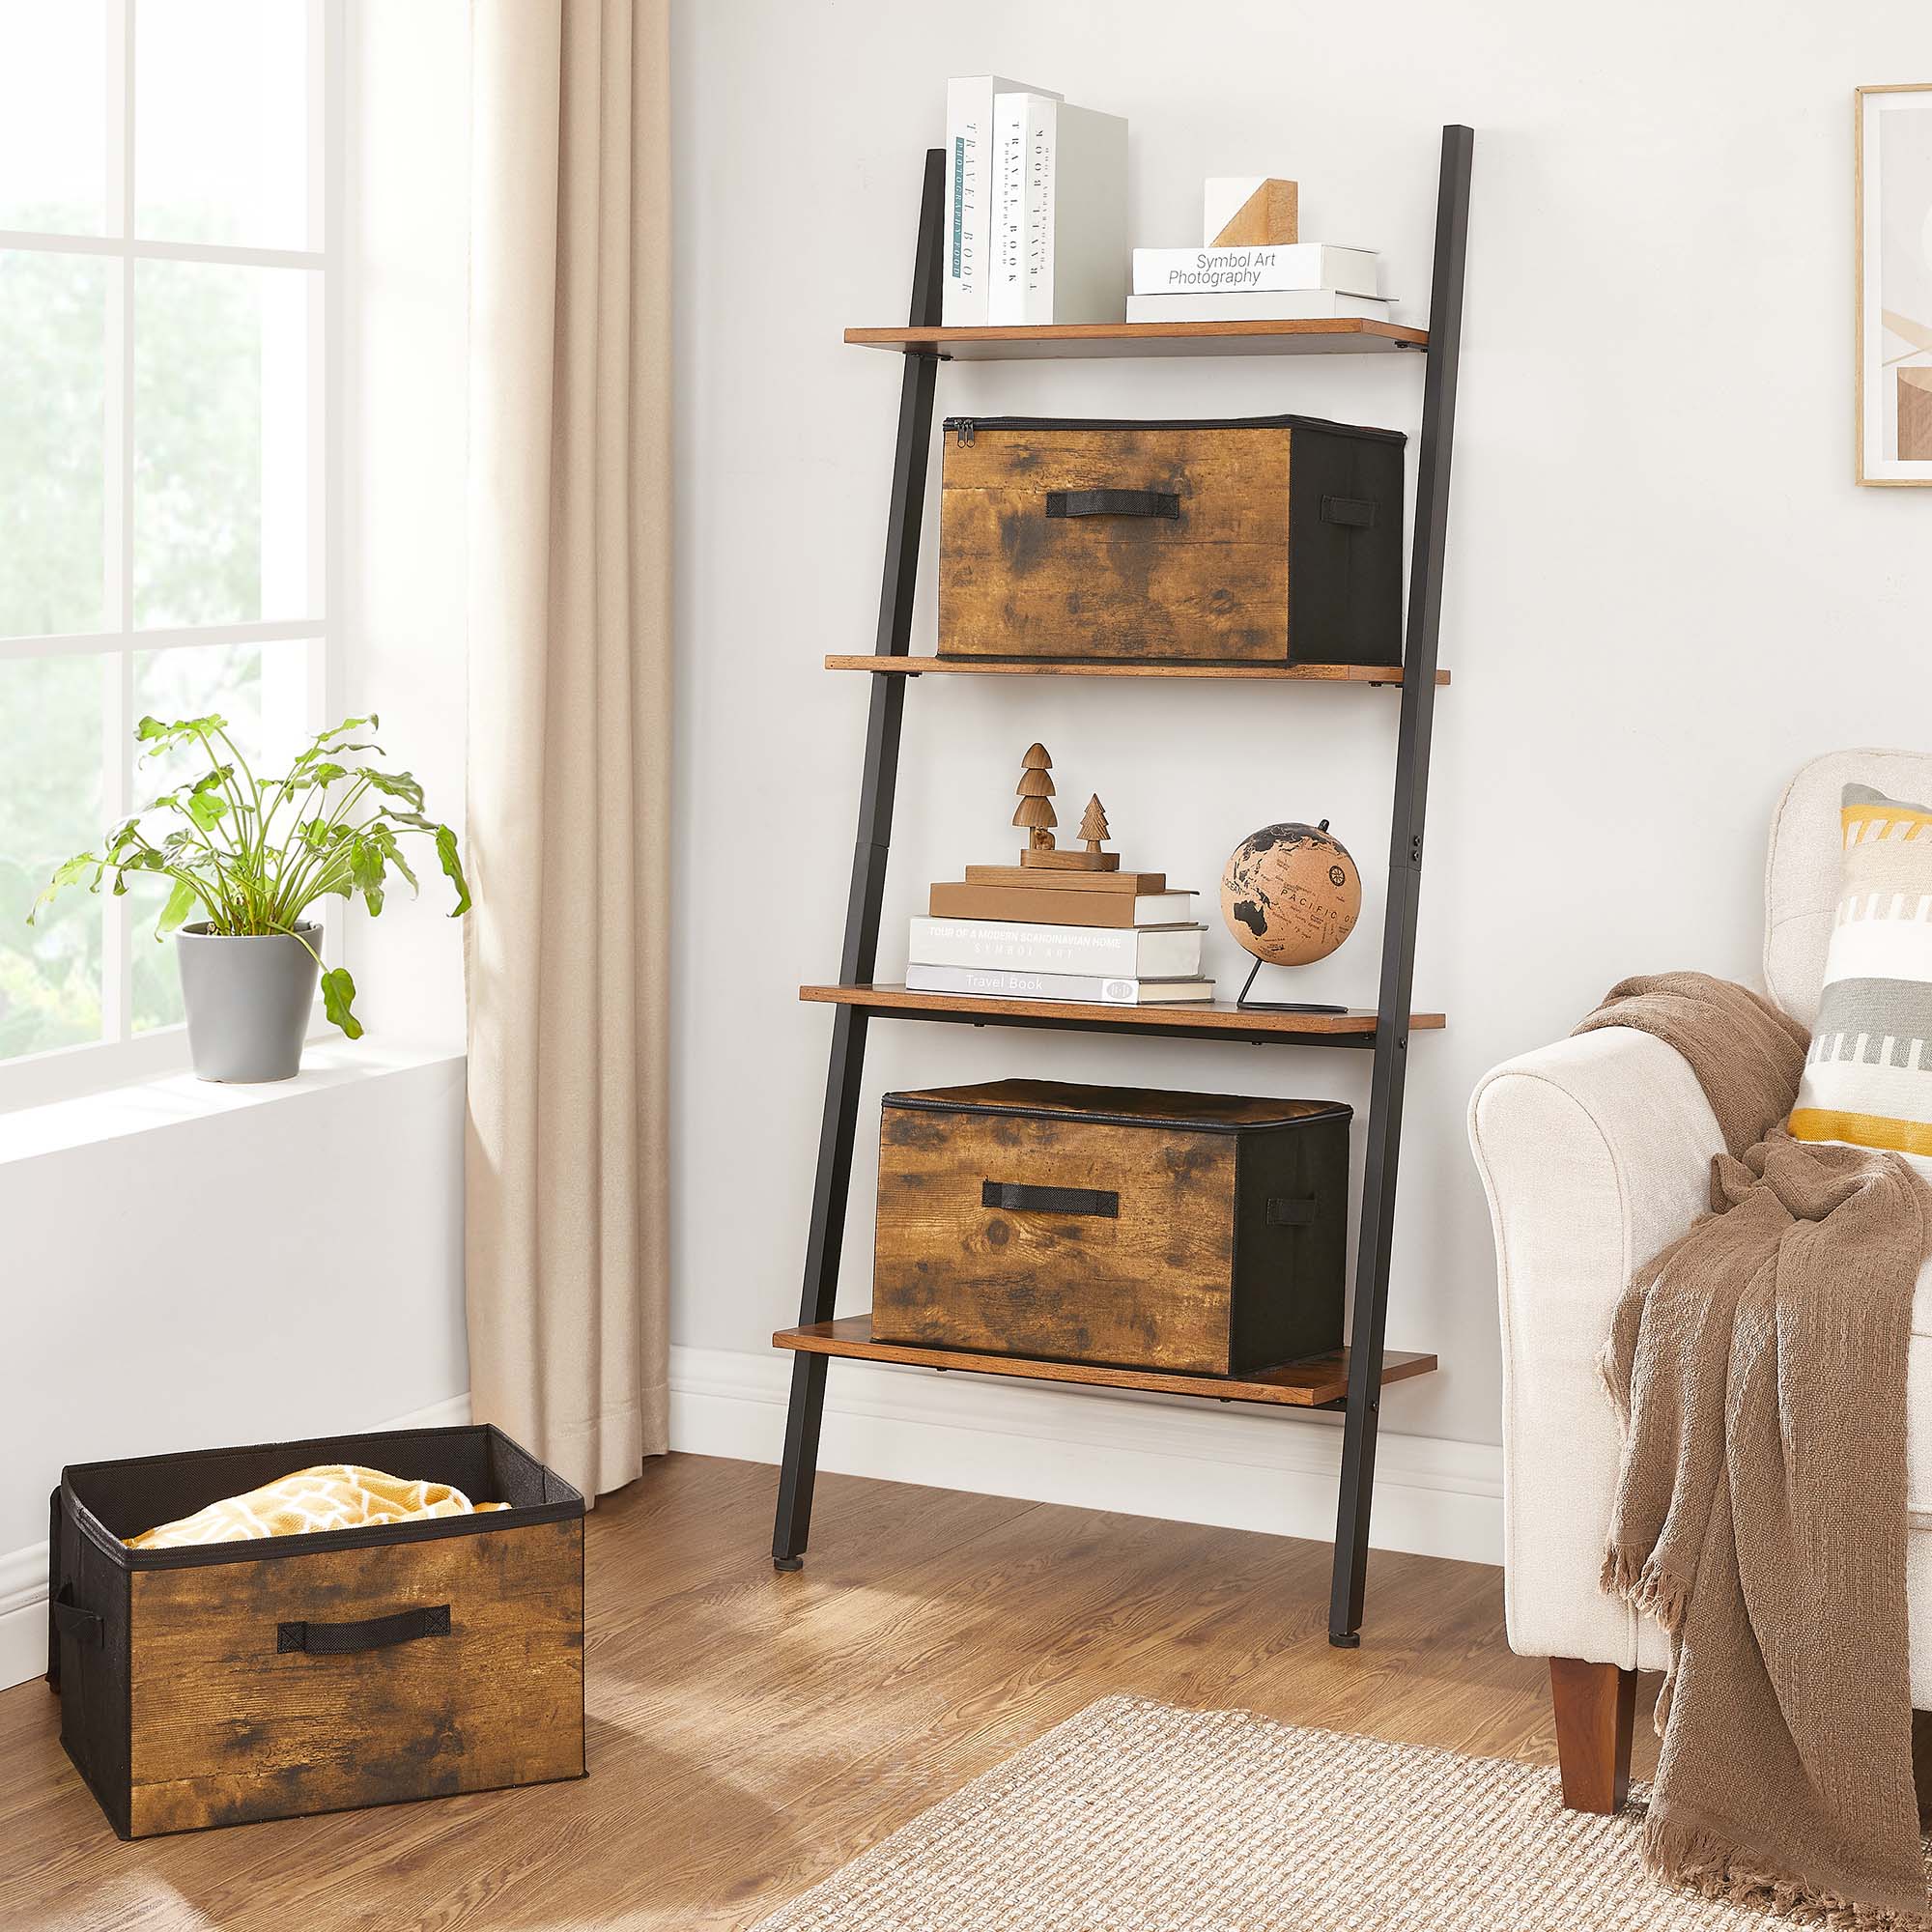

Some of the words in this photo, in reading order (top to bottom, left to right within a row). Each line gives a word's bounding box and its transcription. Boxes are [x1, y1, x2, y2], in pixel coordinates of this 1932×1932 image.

[965, 122, 977, 212] TRAVEL
[1010, 121, 1020, 206] TRAVEL
[1034, 129, 1043, 186] BOOK
[962, 231, 974, 294] BOOK
[1009, 225, 1018, 282] BOOK
[1197, 252, 1251, 271] Symbol
[1255, 252, 1276, 267] Art
[1169, 270, 1262, 287] Photography
[1280, 889, 1338, 920] PACIFIC
[929, 926, 953, 936] TOUR
[955, 927, 967, 937] OF
[970, 929, 977, 938] A
[978, 930, 1018, 941] MODERN
[1020, 933, 1091, 946] SCANDINAVIAN
[1093, 937, 1122, 949] HOME
[974, 942, 1034, 956] SYMBOL
[1046, 949, 1074, 958] ART
[966, 975, 1005, 988] Travel
[1009, 978, 1043, 990] Book
